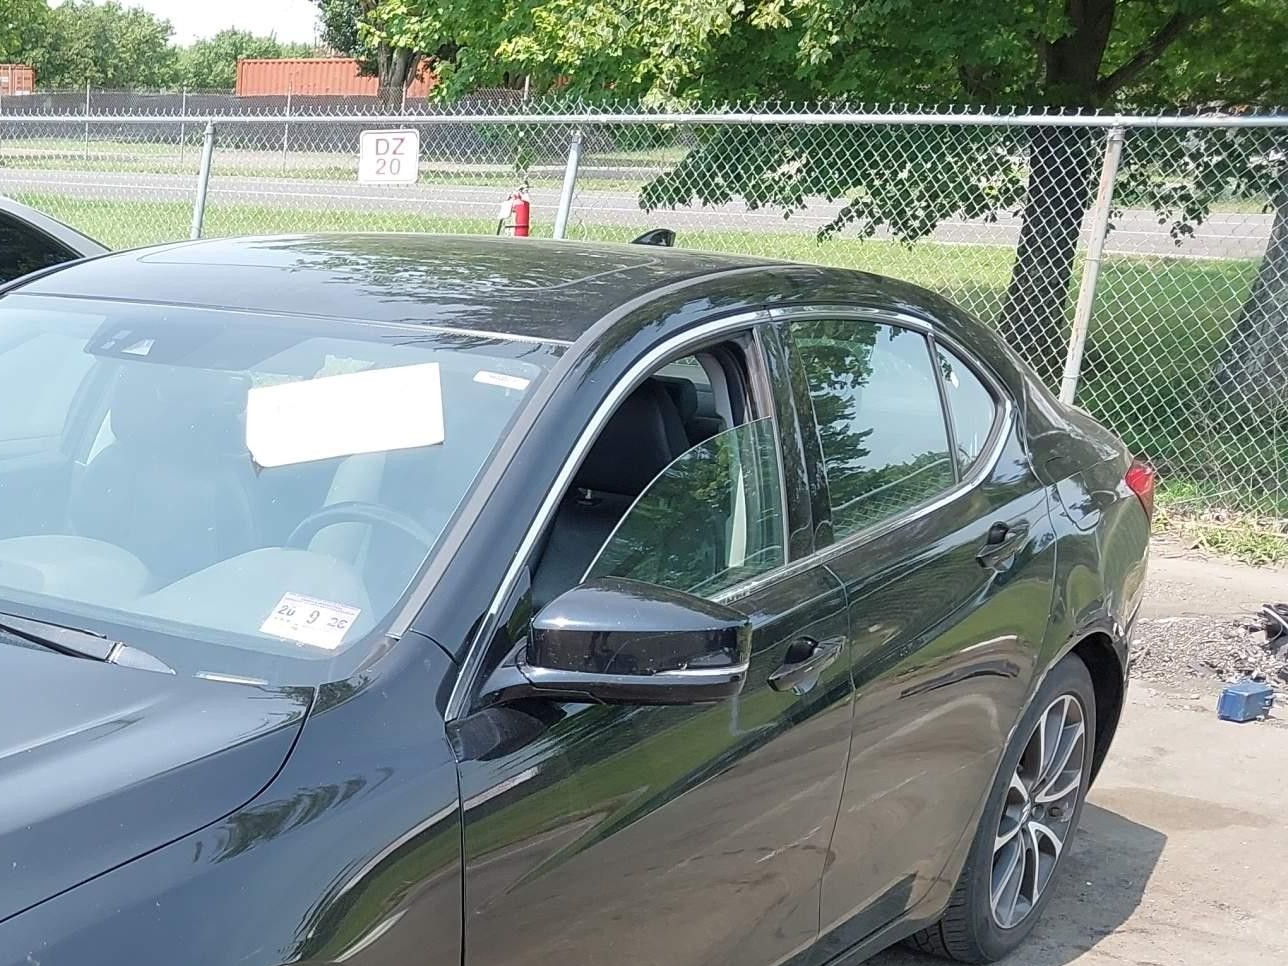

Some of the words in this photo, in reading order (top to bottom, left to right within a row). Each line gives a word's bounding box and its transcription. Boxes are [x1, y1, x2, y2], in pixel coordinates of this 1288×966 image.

[375, 137, 405, 156] DZ
[375, 158, 401, 175] 20
[306, 609, 321, 625] 9
